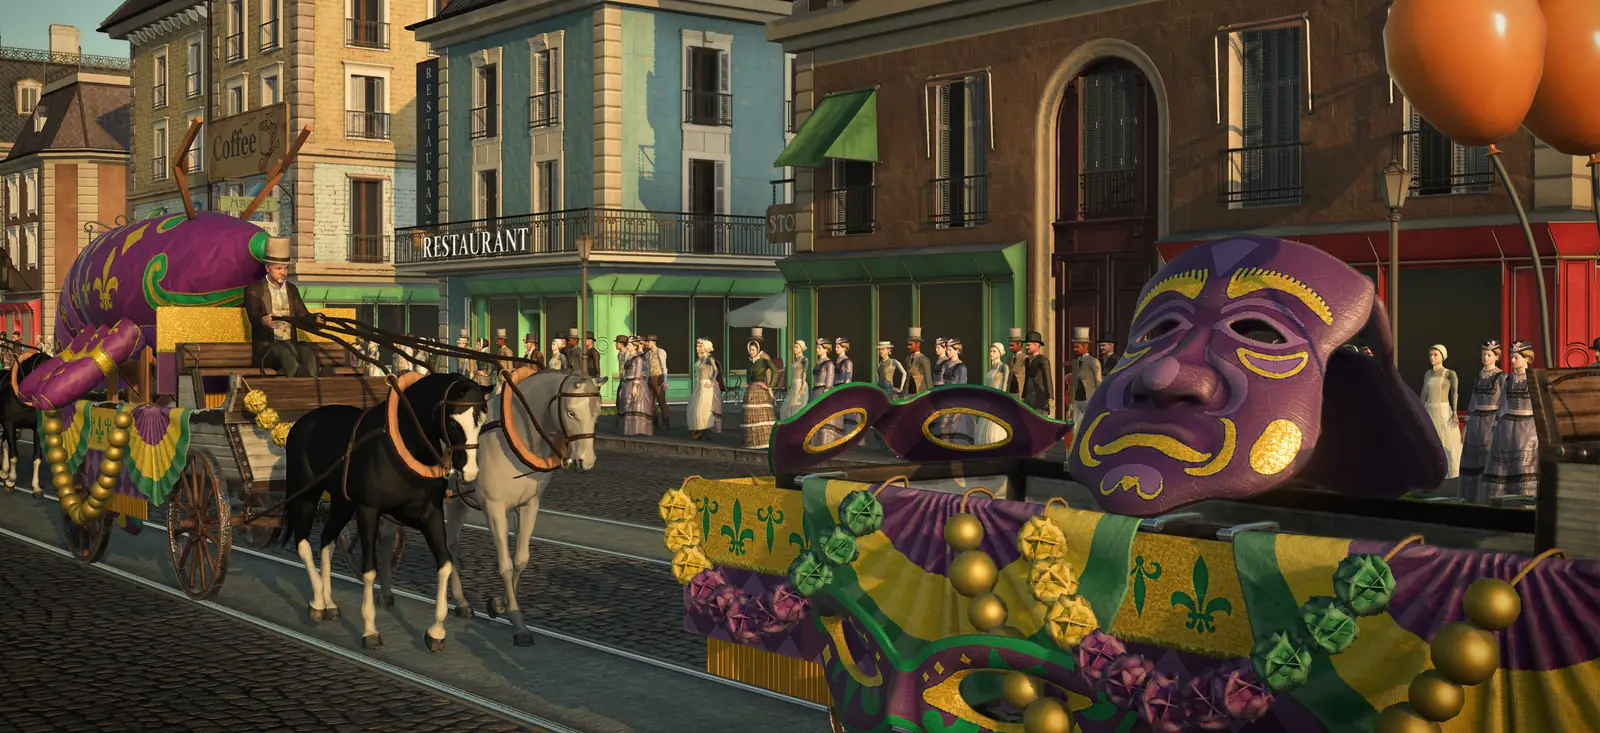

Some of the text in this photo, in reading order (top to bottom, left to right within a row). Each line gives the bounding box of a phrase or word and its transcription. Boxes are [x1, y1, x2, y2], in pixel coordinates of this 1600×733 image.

[213, 128, 257, 161] Coffee
[230, 198, 272, 209] MAT
[423, 227, 529, 258] RESTAURANT
